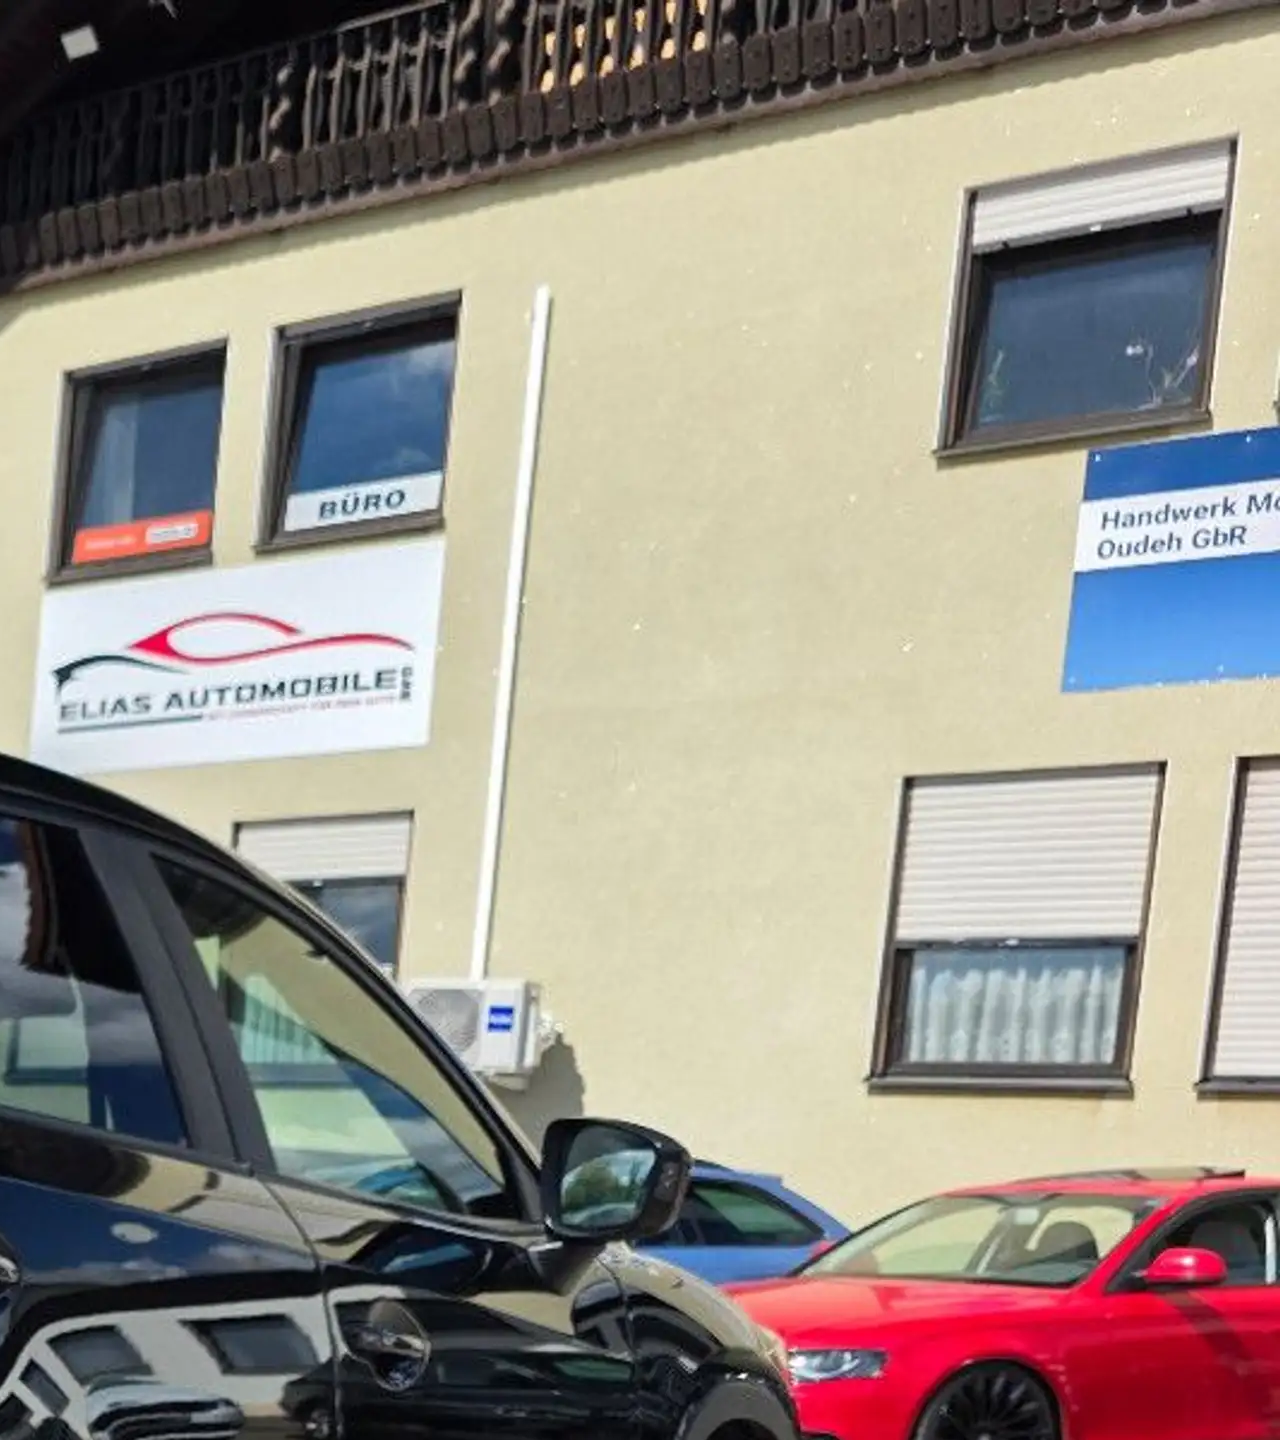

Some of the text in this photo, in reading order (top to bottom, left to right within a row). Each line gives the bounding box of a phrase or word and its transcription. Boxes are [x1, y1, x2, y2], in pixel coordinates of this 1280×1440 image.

[319, 490, 407, 520] BÜRO
[1101, 496, 1237, 531] Handwerk
[1097, 525, 1248, 560] Oudeh GbR
[60, 695, 153, 723] ELIAS
[165, 668, 397, 712] AUTOMOBILE
